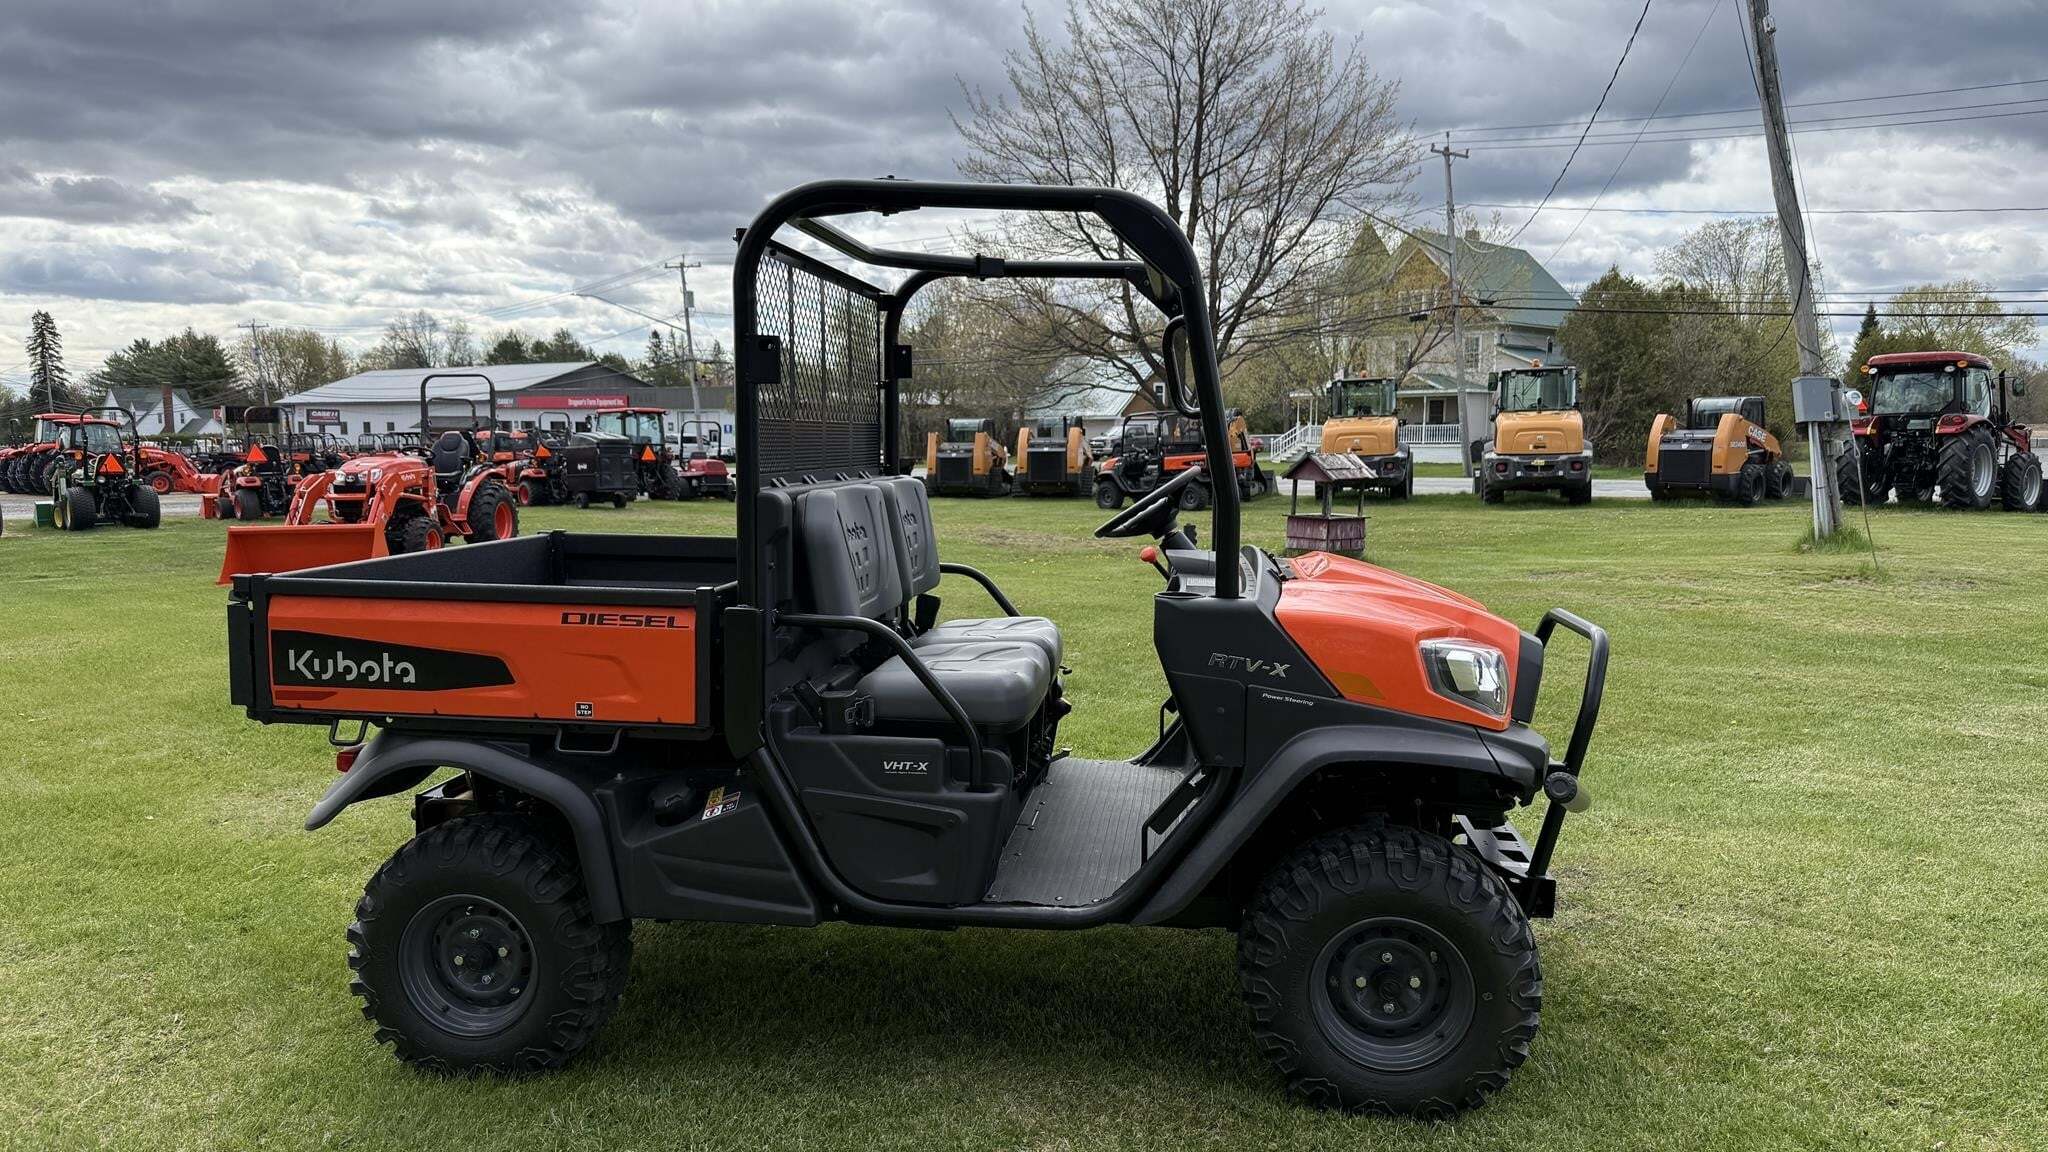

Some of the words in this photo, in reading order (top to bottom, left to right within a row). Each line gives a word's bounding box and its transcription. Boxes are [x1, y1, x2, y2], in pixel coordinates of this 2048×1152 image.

[1748, 425, 1767, 444] CASE
[560, 611, 690, 629] DIESEL
[288, 649, 416, 684] Kubota
[1207, 652, 1292, 678] RTV-X
[1262, 692, 1283, 701] Power
[1285, 696, 1314, 706] Steering
[883, 761, 929, 771] VHT-X
